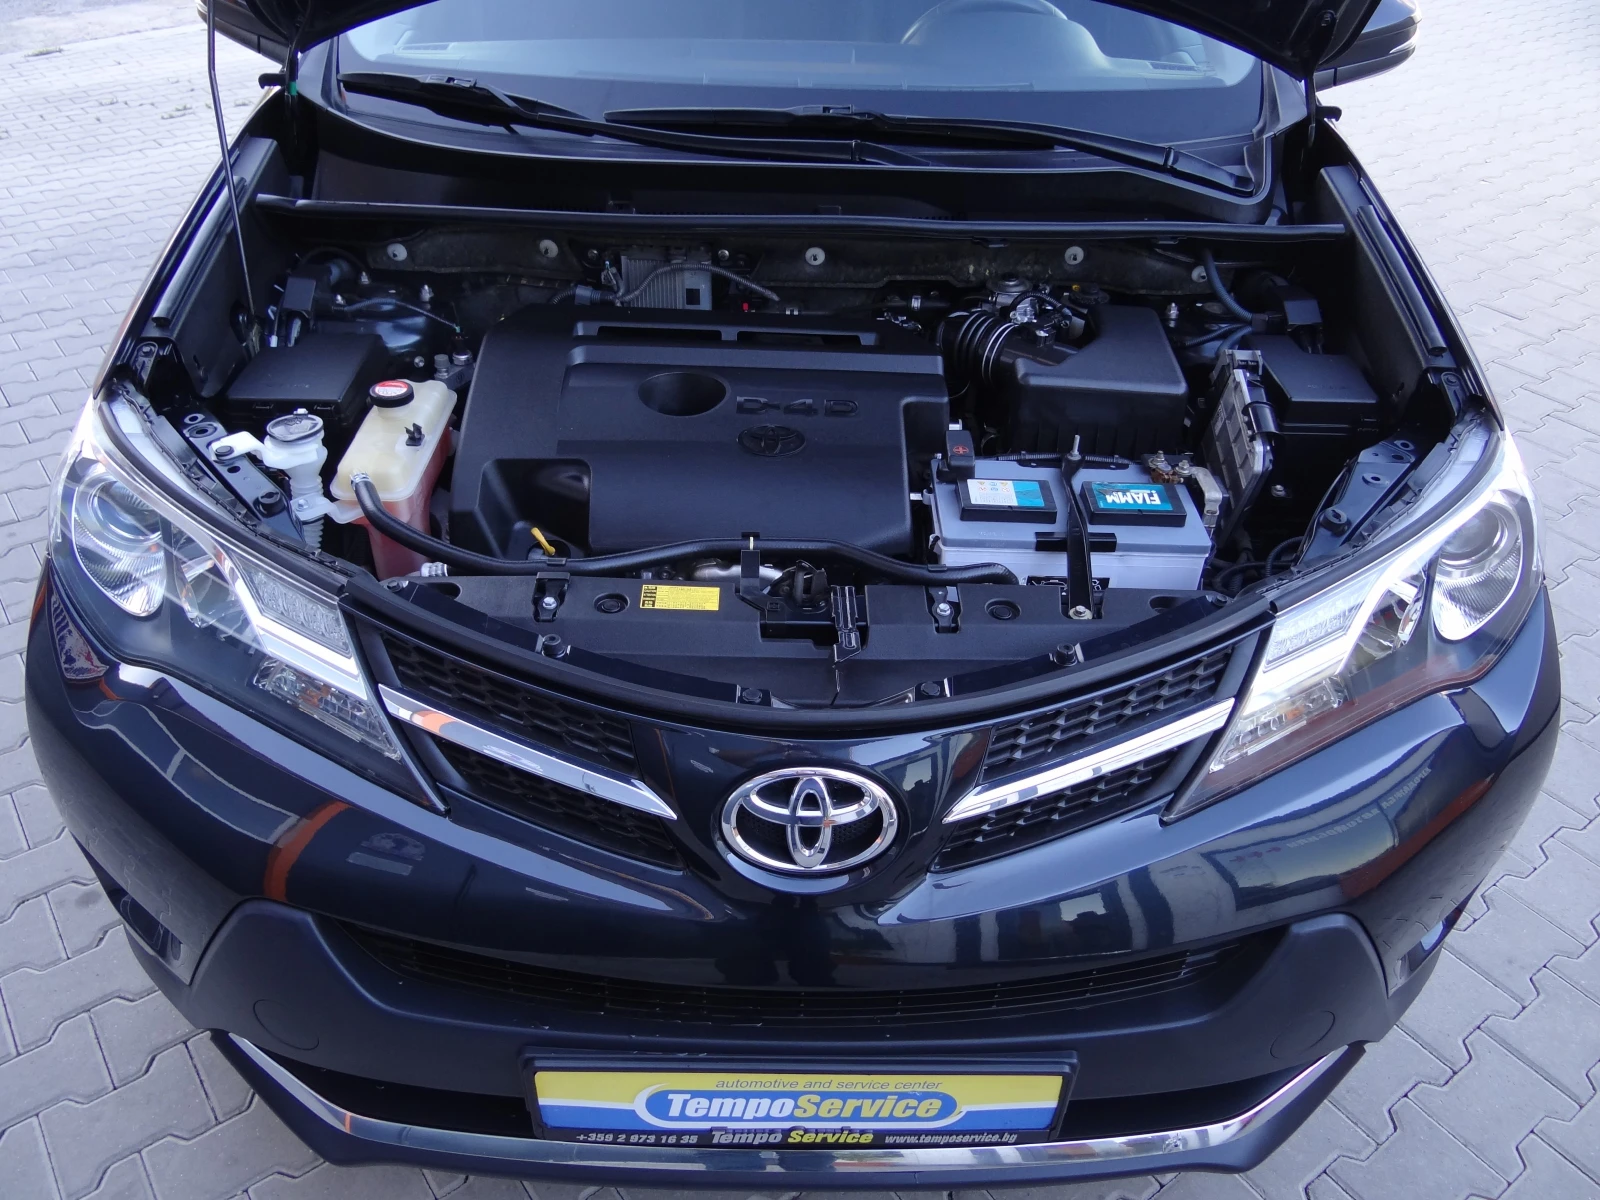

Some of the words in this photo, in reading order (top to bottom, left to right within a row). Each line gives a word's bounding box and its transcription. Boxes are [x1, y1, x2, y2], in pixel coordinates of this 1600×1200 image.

[1105, 490, 1162, 505] FIAMM
[715, 1079, 799, 1089] automotive
[803, 1080, 833, 1089] and
[836, 1080, 890, 1090] service
[894, 1081, 943, 1090] center
[576, 1132, 613, 1142] +359
[617, 1133, 627, 1142] 2
[629, 1134, 656, 1143] 973
[661, 1135, 677, 1143] 16
[680, 1135, 699, 1144] 35
[711, 1129, 783, 1144] Tempo
[787, 1129, 874, 1143] Service
[884, 1132, 1018, 1144] www.temposervice.bg
